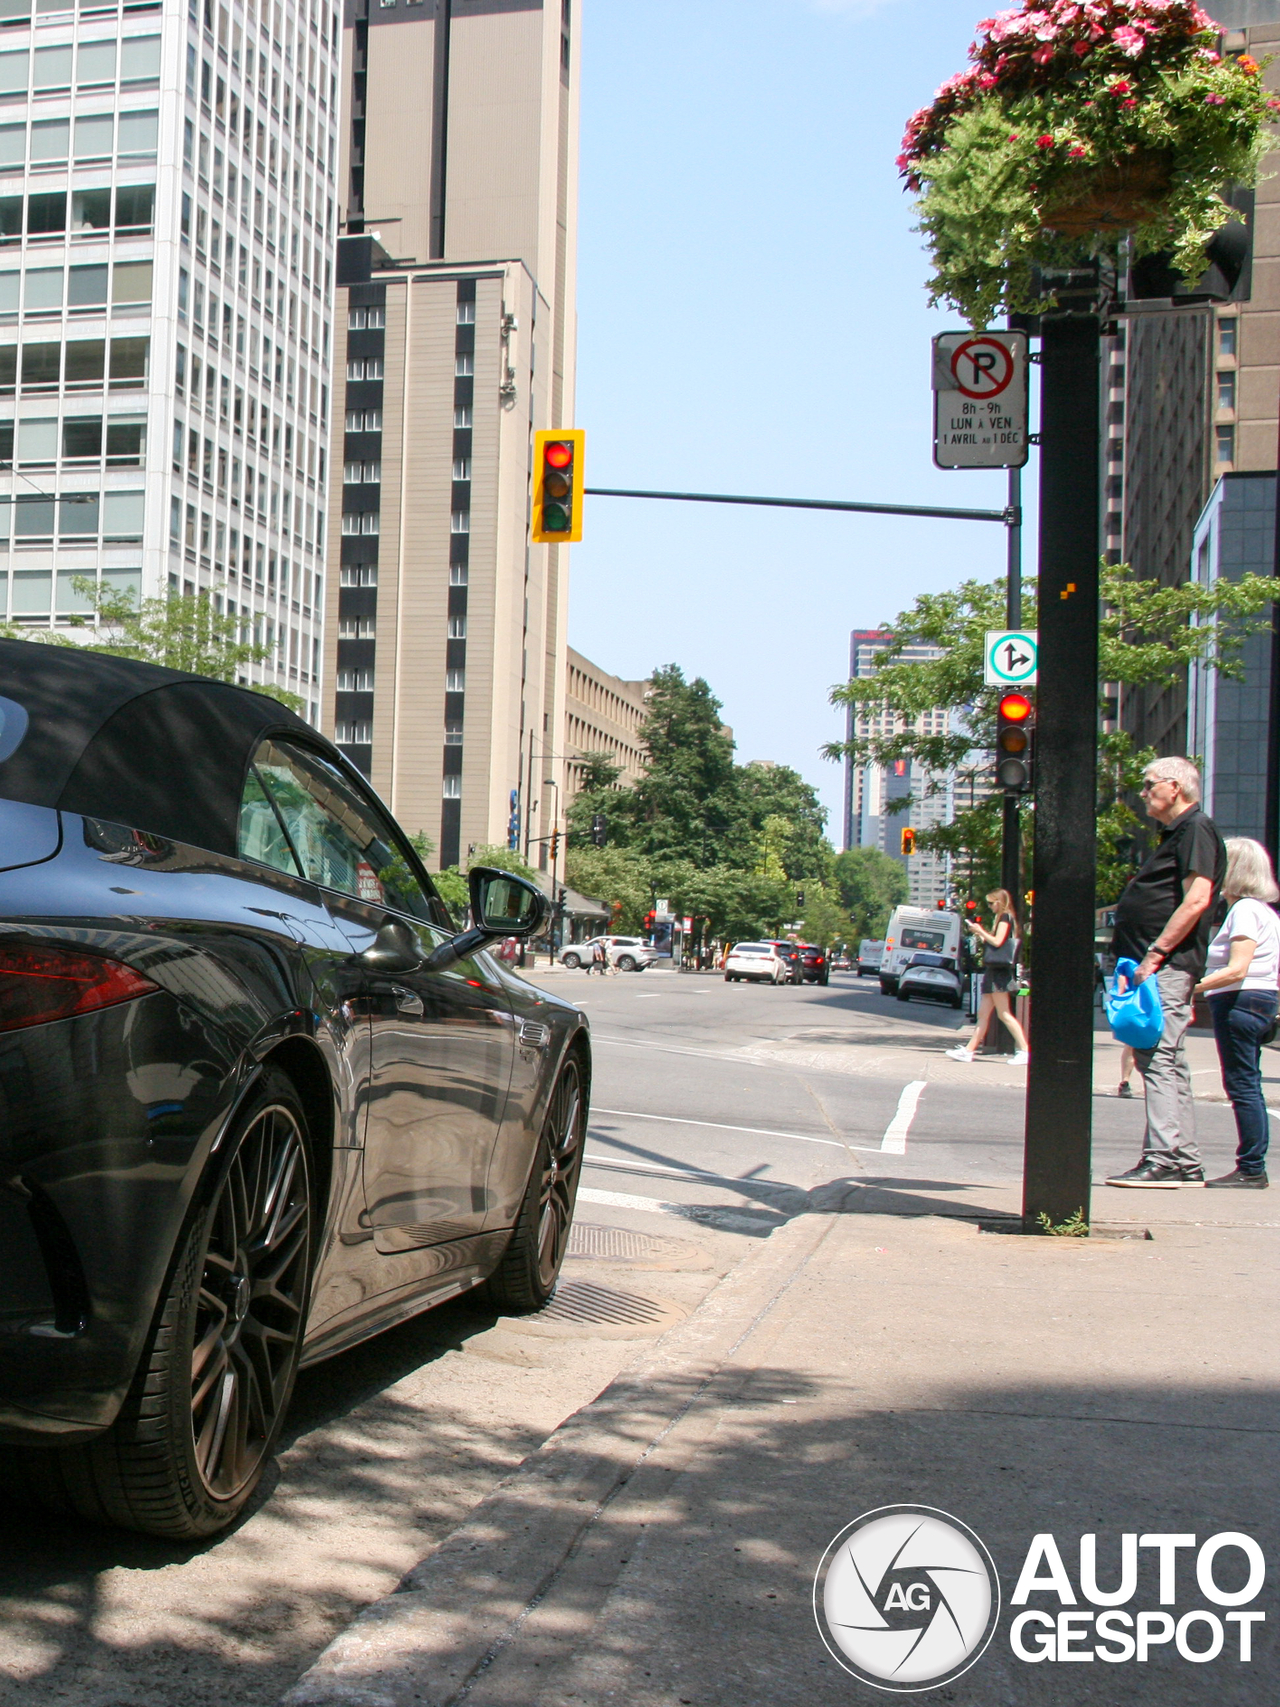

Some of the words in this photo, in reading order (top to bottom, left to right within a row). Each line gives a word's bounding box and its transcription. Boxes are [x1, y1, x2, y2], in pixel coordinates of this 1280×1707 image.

[962, 402, 976, 414] 8h
[986, 402, 1001, 414] 9h
[950, 418, 972, 430] LUN
[989, 416, 1012, 430] VEN
[950, 433, 978, 445] AVRIL
[982, 436, 991, 444] AU
[1001, 430, 1018, 444] DÉC
